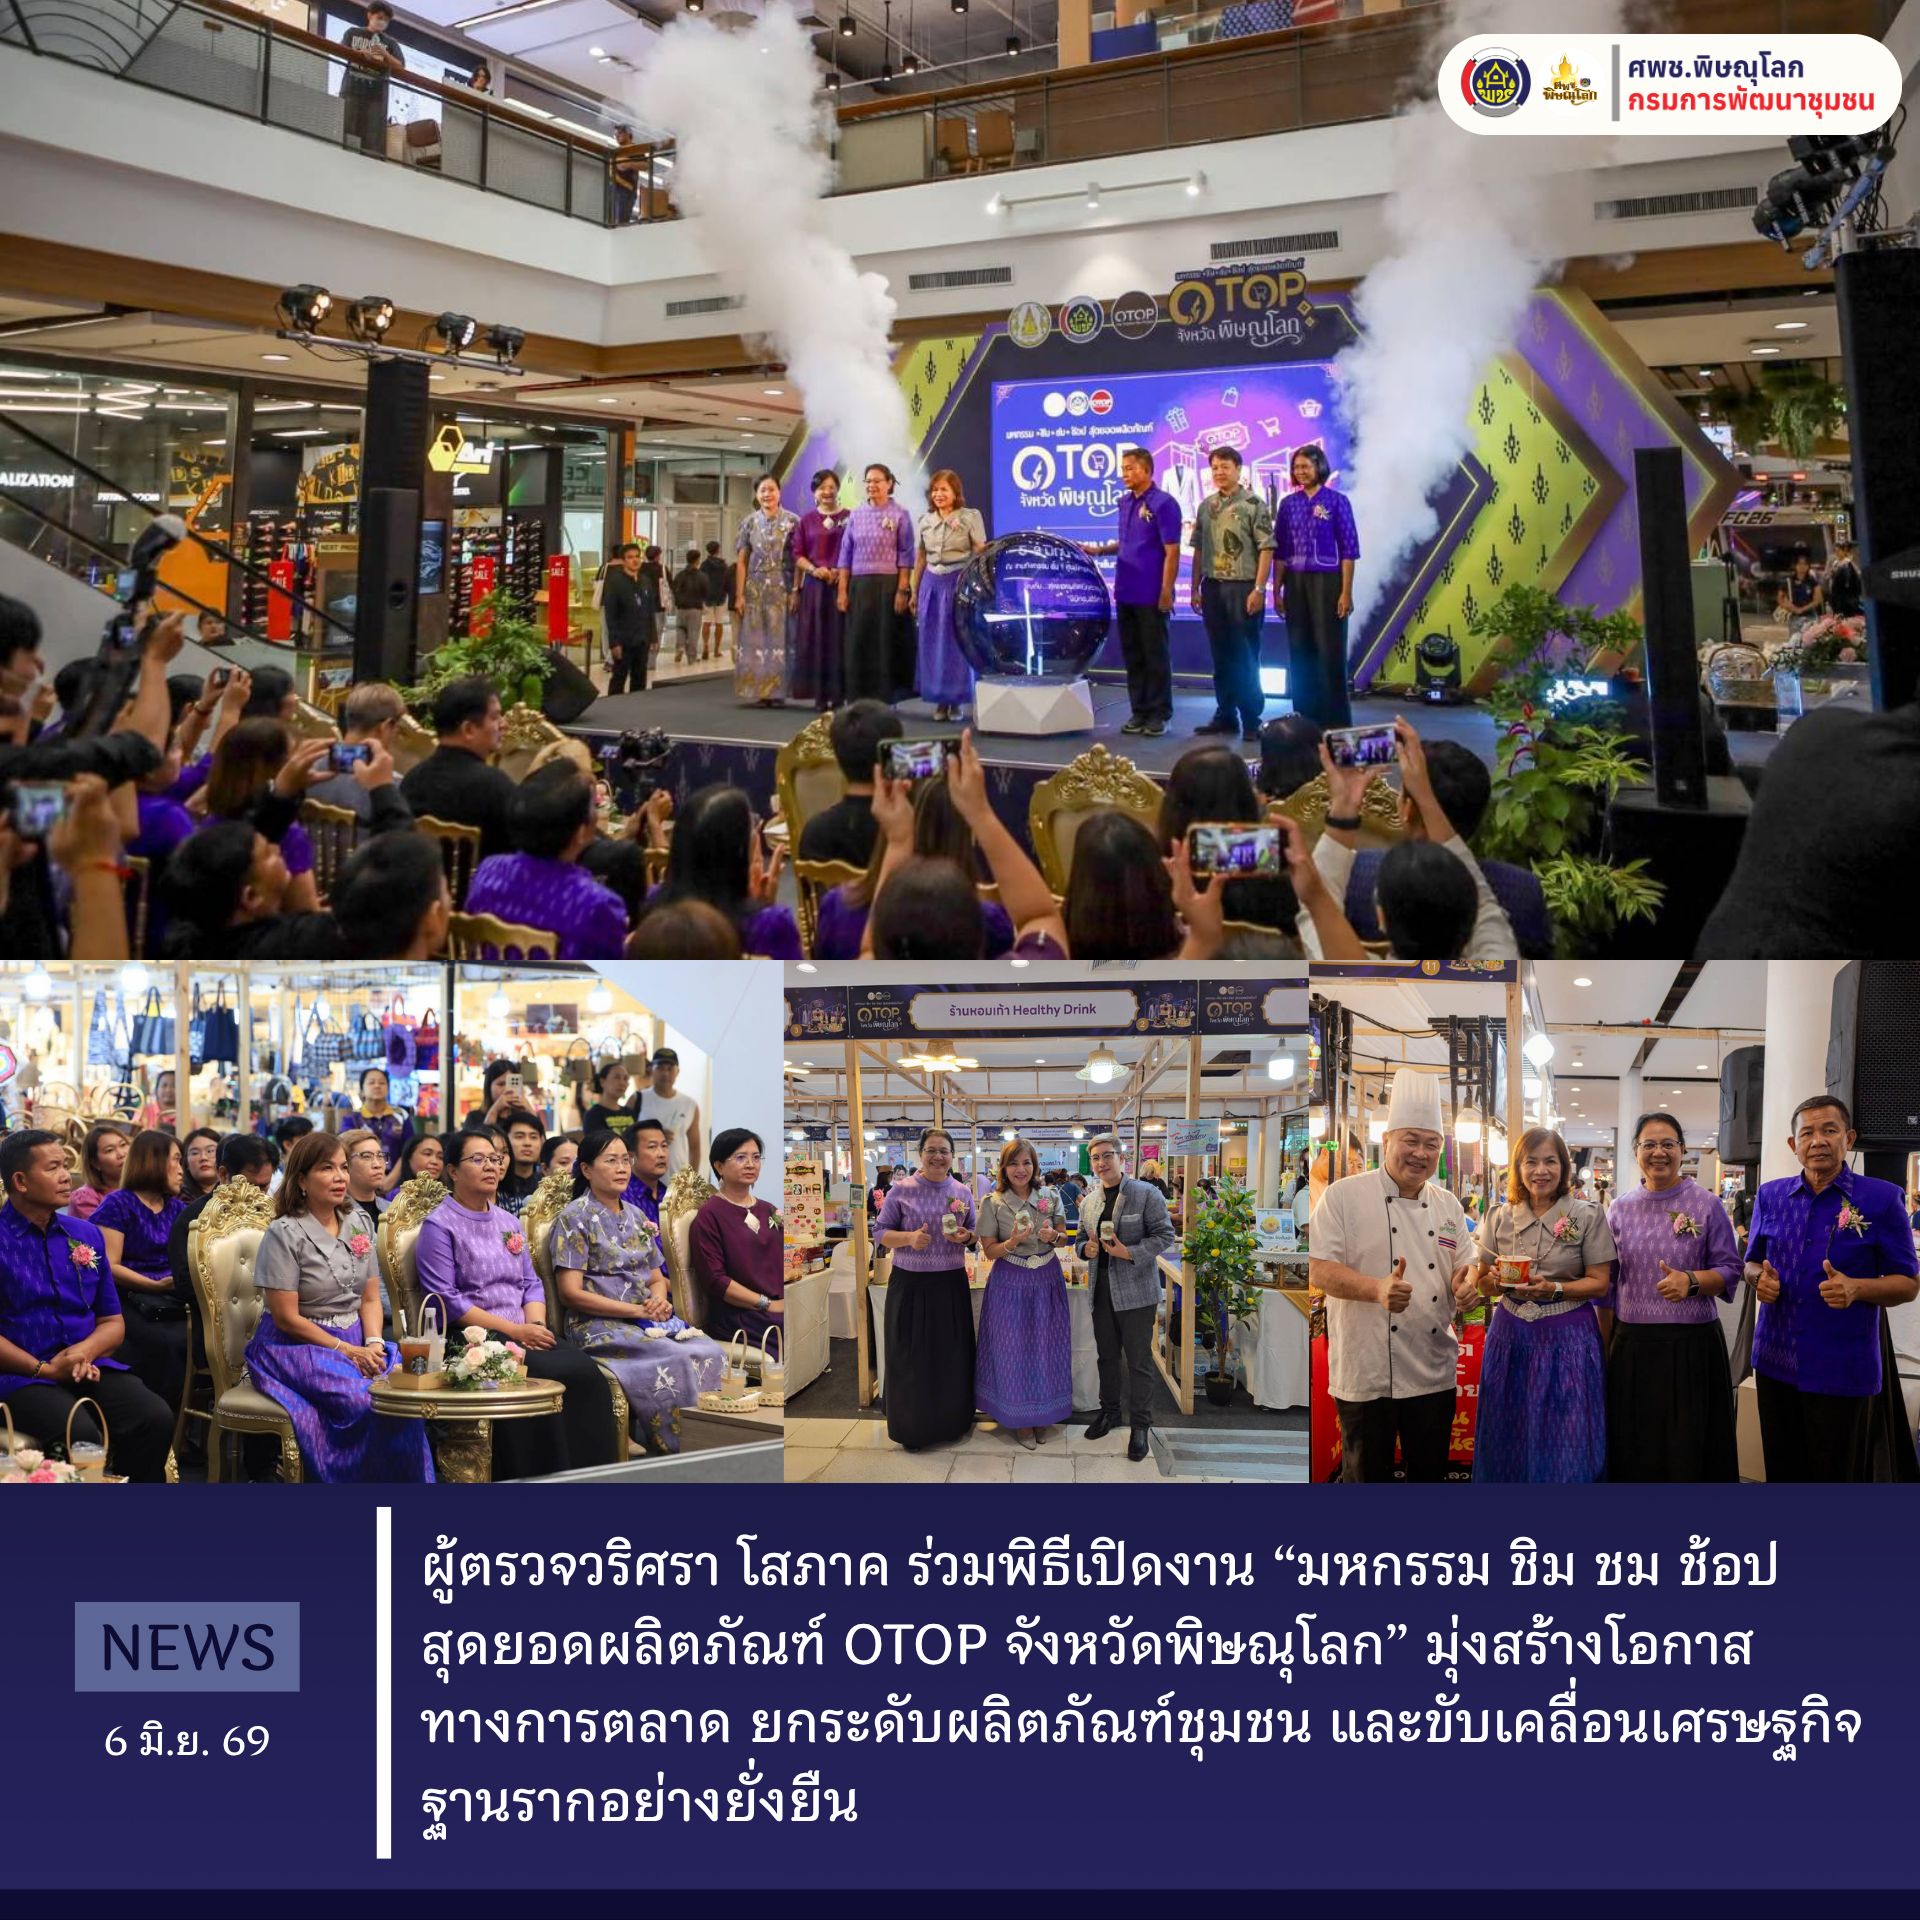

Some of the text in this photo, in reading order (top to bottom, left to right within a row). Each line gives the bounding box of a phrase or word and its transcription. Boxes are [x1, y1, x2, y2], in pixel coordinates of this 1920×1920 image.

[1169, 271, 1305, 326] OTOP
[1115, 309, 1154, 322] OTOP
[1178, 310, 1303, 347] จังหวัด พิษณุโลก
[1020, 480, 1131, 517] จังหวัด พิษณุโล
[1721, 512, 1776, 525] FC26
[1425, 961, 1436, 971] 11
[857, 1007, 899, 1022] OTOP
[1013, 1003, 1060, 1018] Healthy
[1064, 1003, 1096, 1015] Drink
[1207, 1002, 1252, 1017] OTOP
